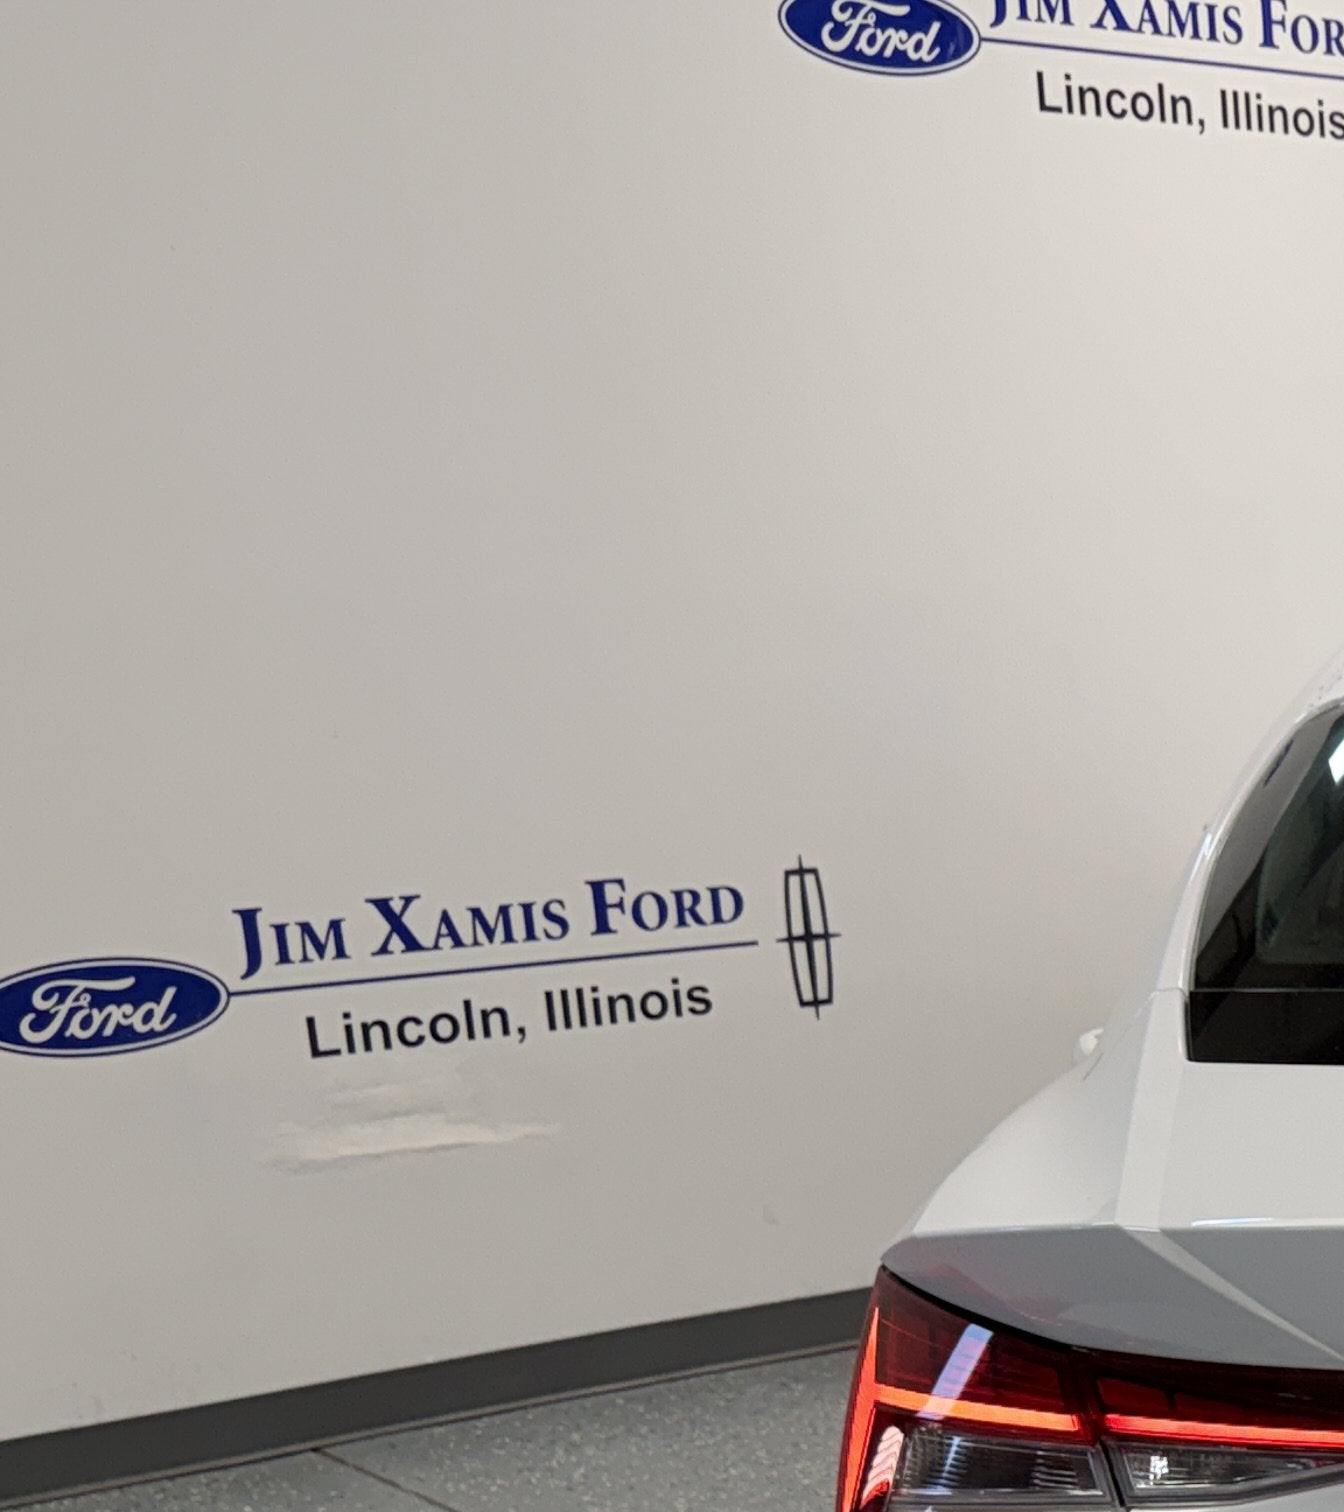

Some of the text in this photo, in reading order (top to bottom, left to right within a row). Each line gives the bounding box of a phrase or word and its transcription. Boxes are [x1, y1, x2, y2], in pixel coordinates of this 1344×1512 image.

[821, 0, 941, 63] Ford
[1037, 71, 1204, 134] Lincoln,
[232, 879, 743, 979] JIM XAMIS FORD
[19, 976, 178, 1045] Ford
[306, 978, 712, 1058] Lincoln, Illinois
